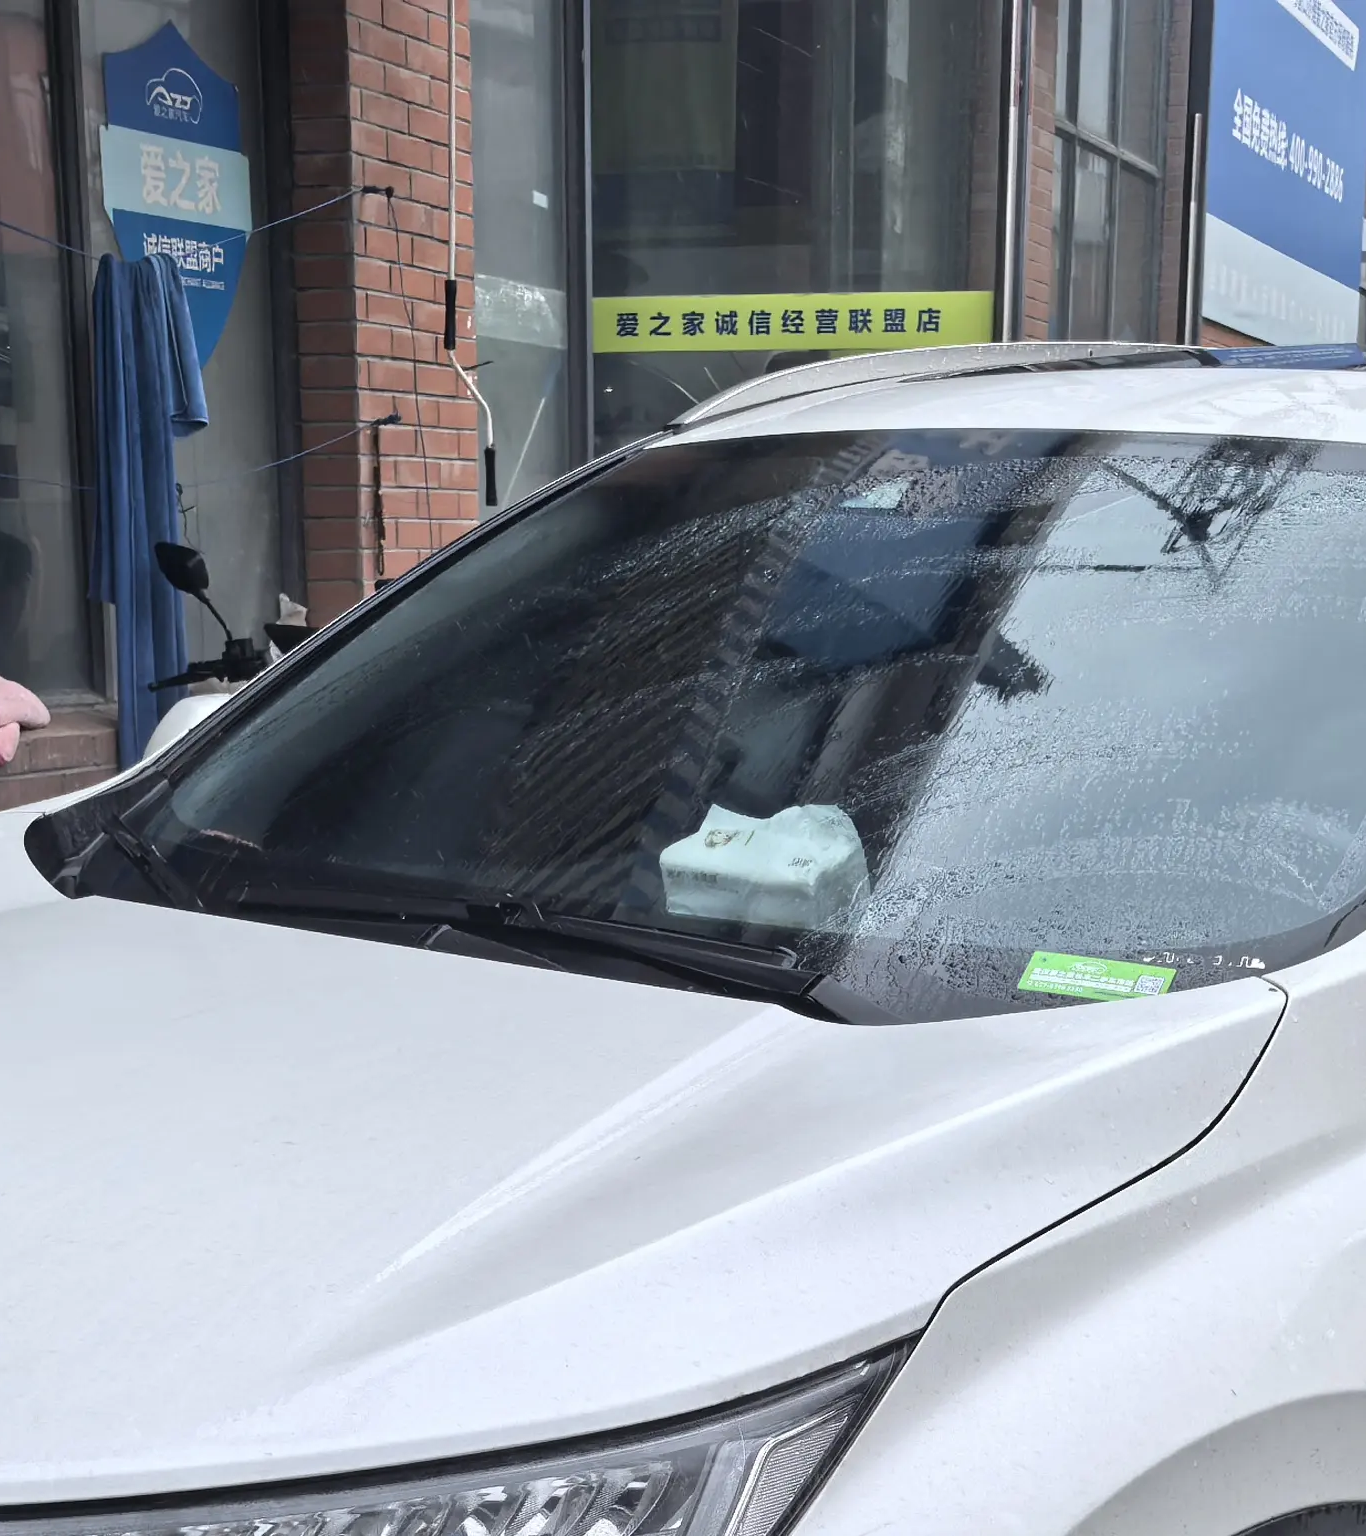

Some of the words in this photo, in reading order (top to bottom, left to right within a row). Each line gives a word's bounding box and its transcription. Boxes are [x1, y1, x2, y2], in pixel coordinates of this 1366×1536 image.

[1232, 87, 1288, 171] 全国免费热线
[139, 142, 222, 216] 爱之家
[616, 308, 941, 337] 爱之家诚信经营联盟店
